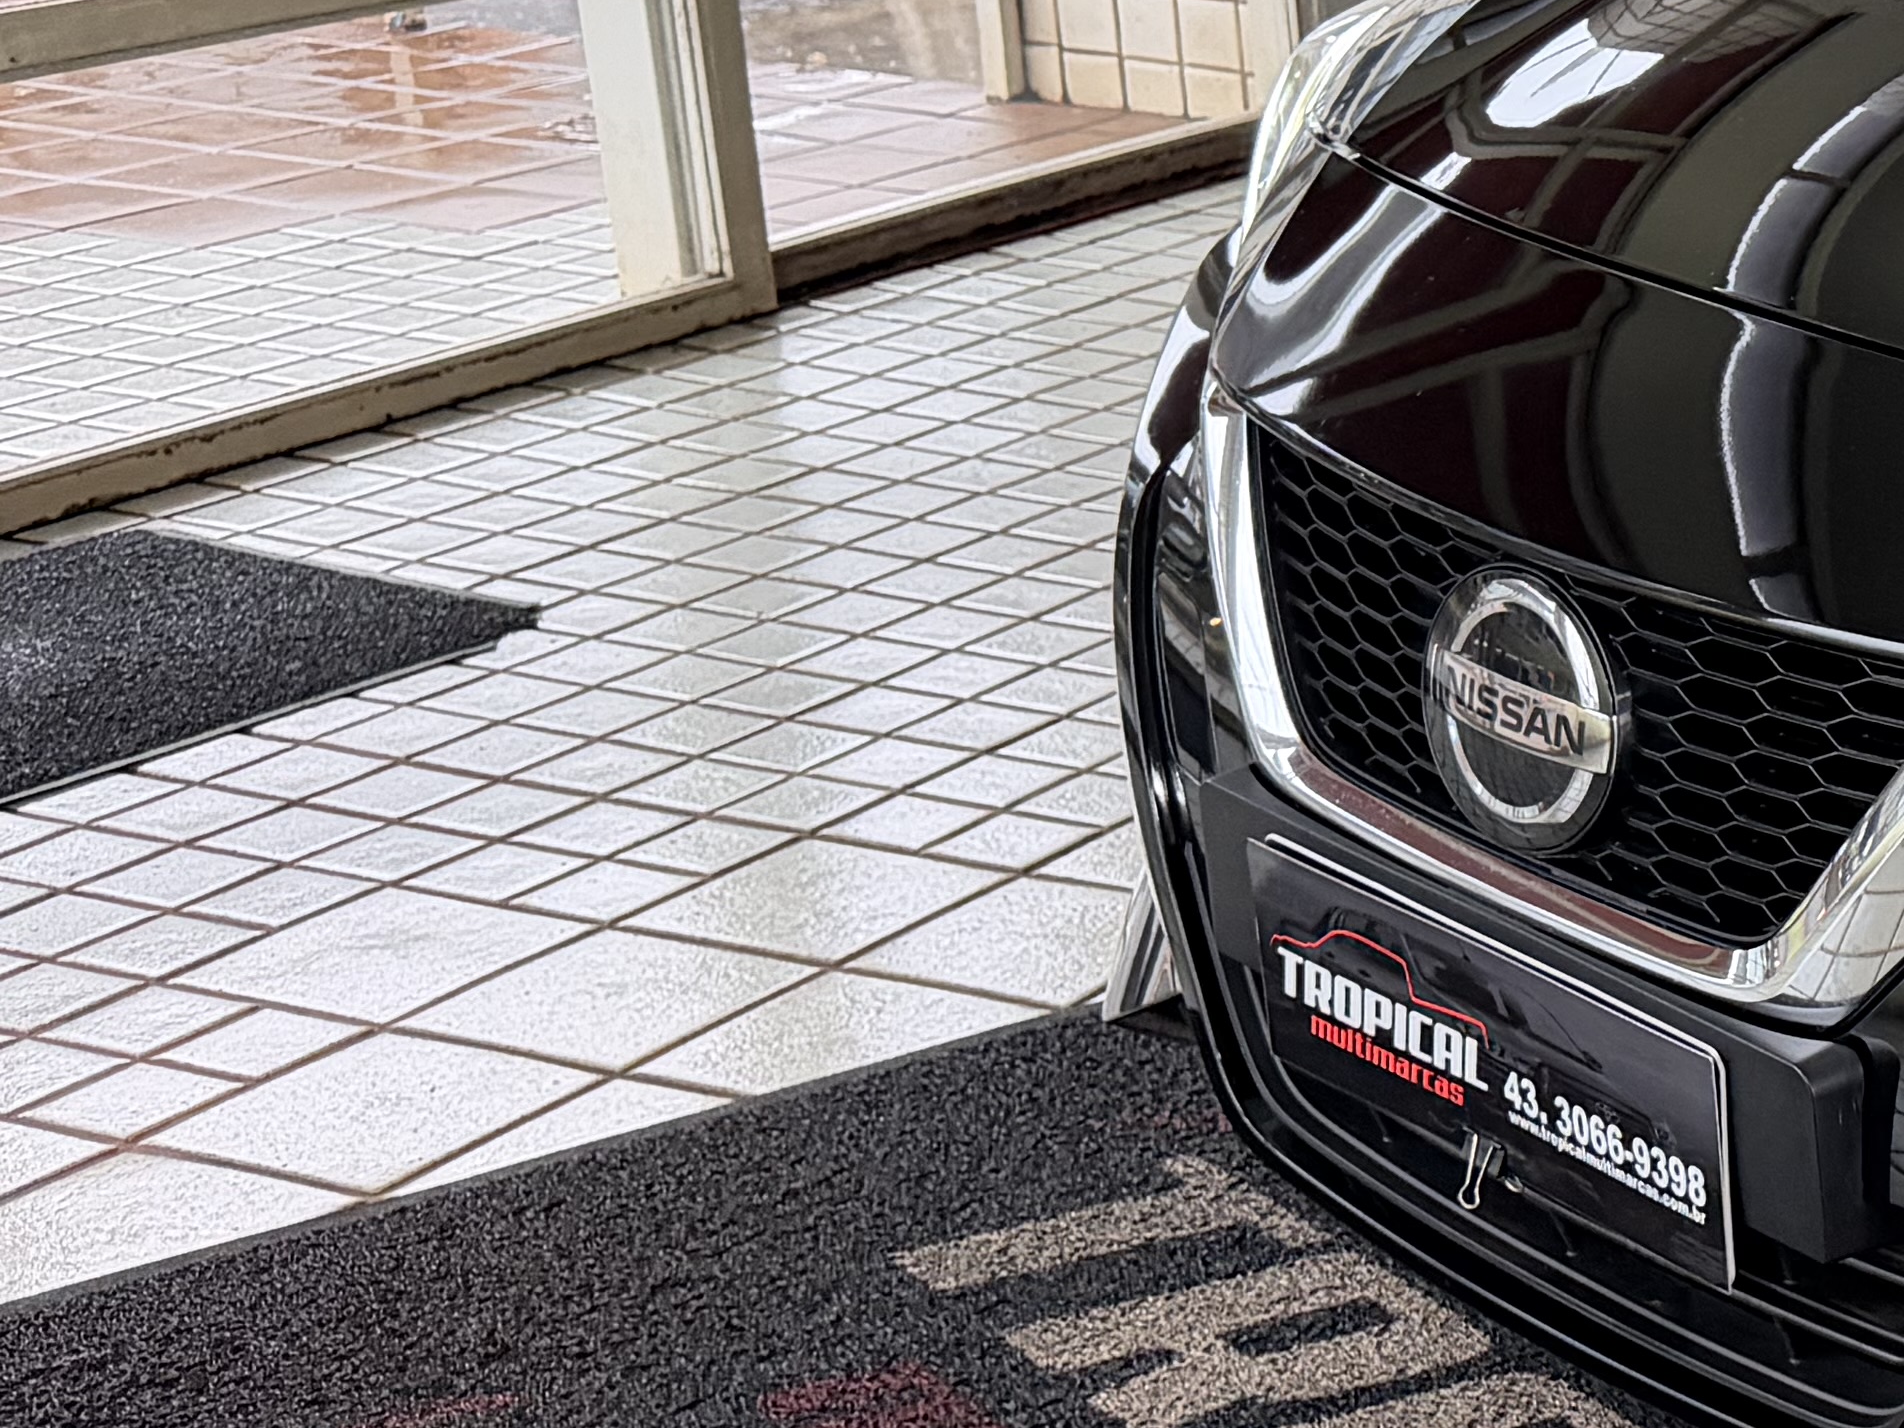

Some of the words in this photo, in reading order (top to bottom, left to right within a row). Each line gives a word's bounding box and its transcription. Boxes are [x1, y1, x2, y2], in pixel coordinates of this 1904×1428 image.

[1447, 665, 1586, 756] NISSAN
[1277, 945, 1489, 1092] TROPICAL
[1310, 1014, 1465, 1107] multimarcas
[1508, 1110, 1707, 1225] www.tropicalmultimarcas.com.br
[1553, 1095, 1707, 1207] 3066-9398
